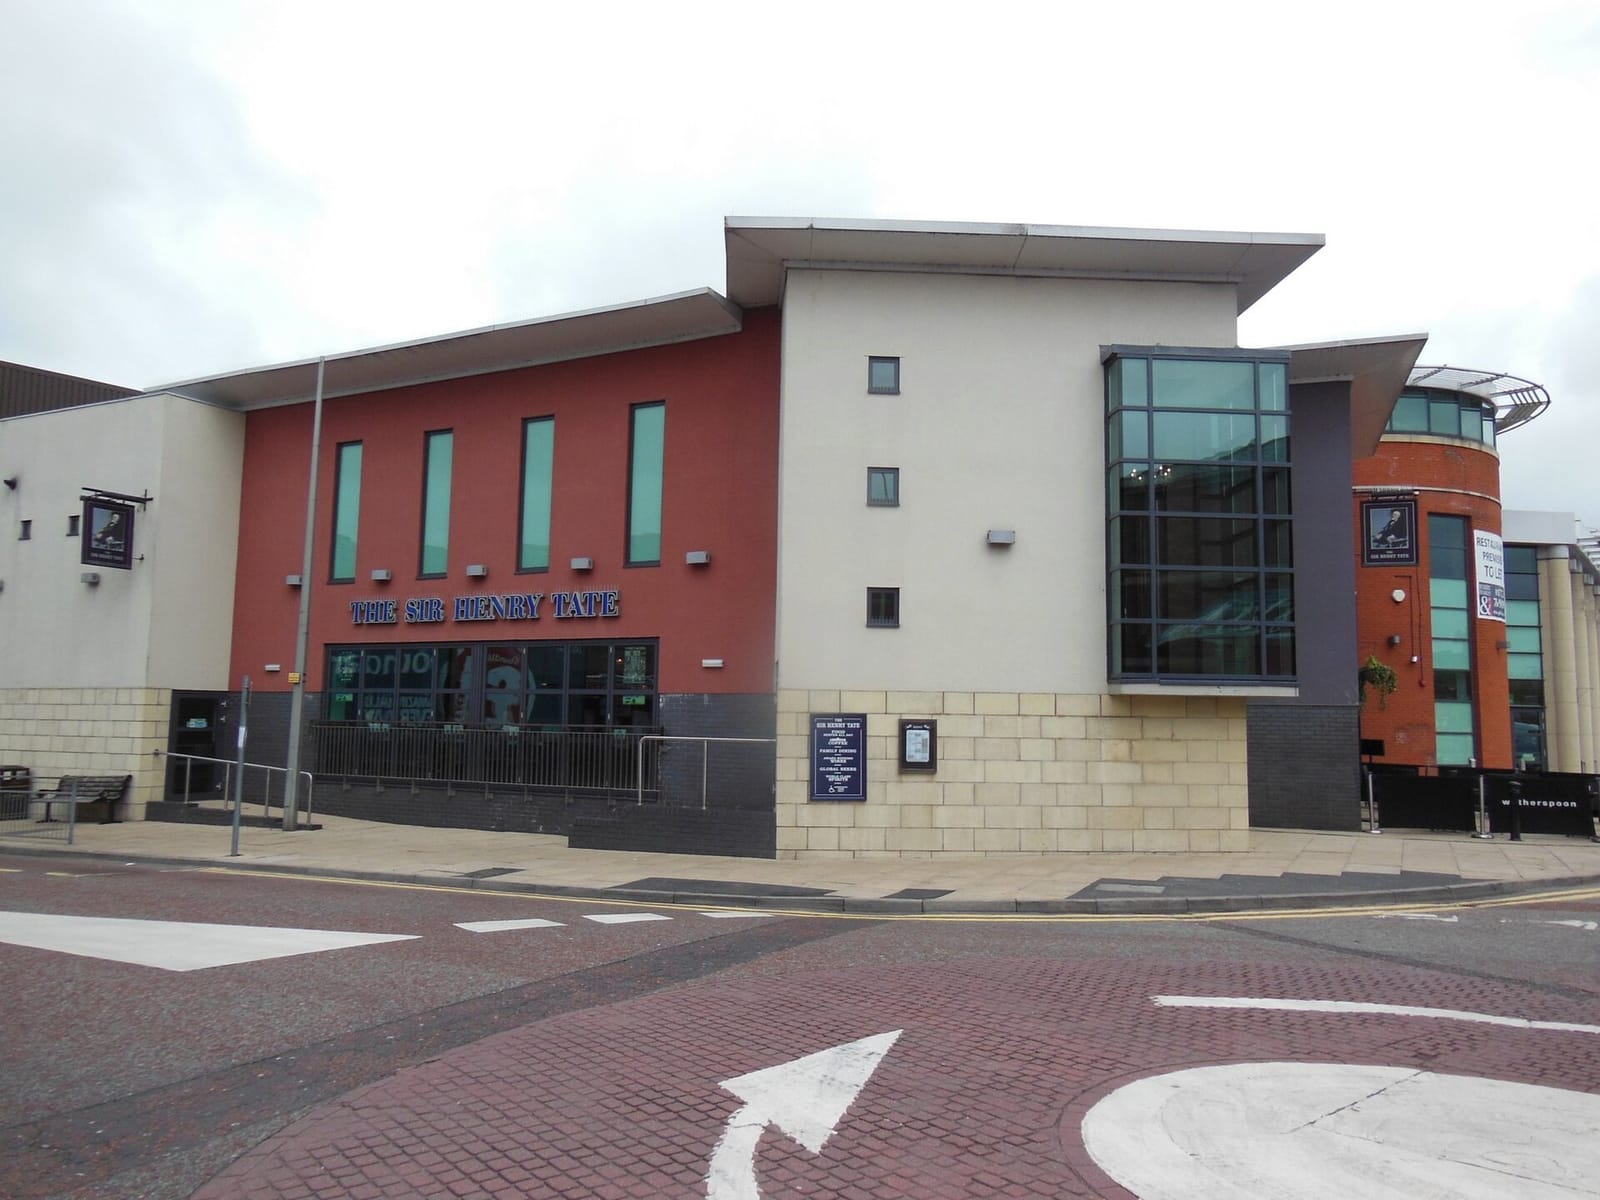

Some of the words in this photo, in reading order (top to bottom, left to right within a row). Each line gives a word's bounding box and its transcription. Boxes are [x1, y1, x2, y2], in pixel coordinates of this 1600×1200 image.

[1483, 565, 1494, 578] TO
[1495, 566, 1503, 580] LE
[350, 600, 397, 624] THE
[404, 598, 445, 623] SIR
[453, 594, 543, 621] HENRY
[551, 590, 619, 618] TATE
[1501, 798, 1577, 808] wtherspoon
